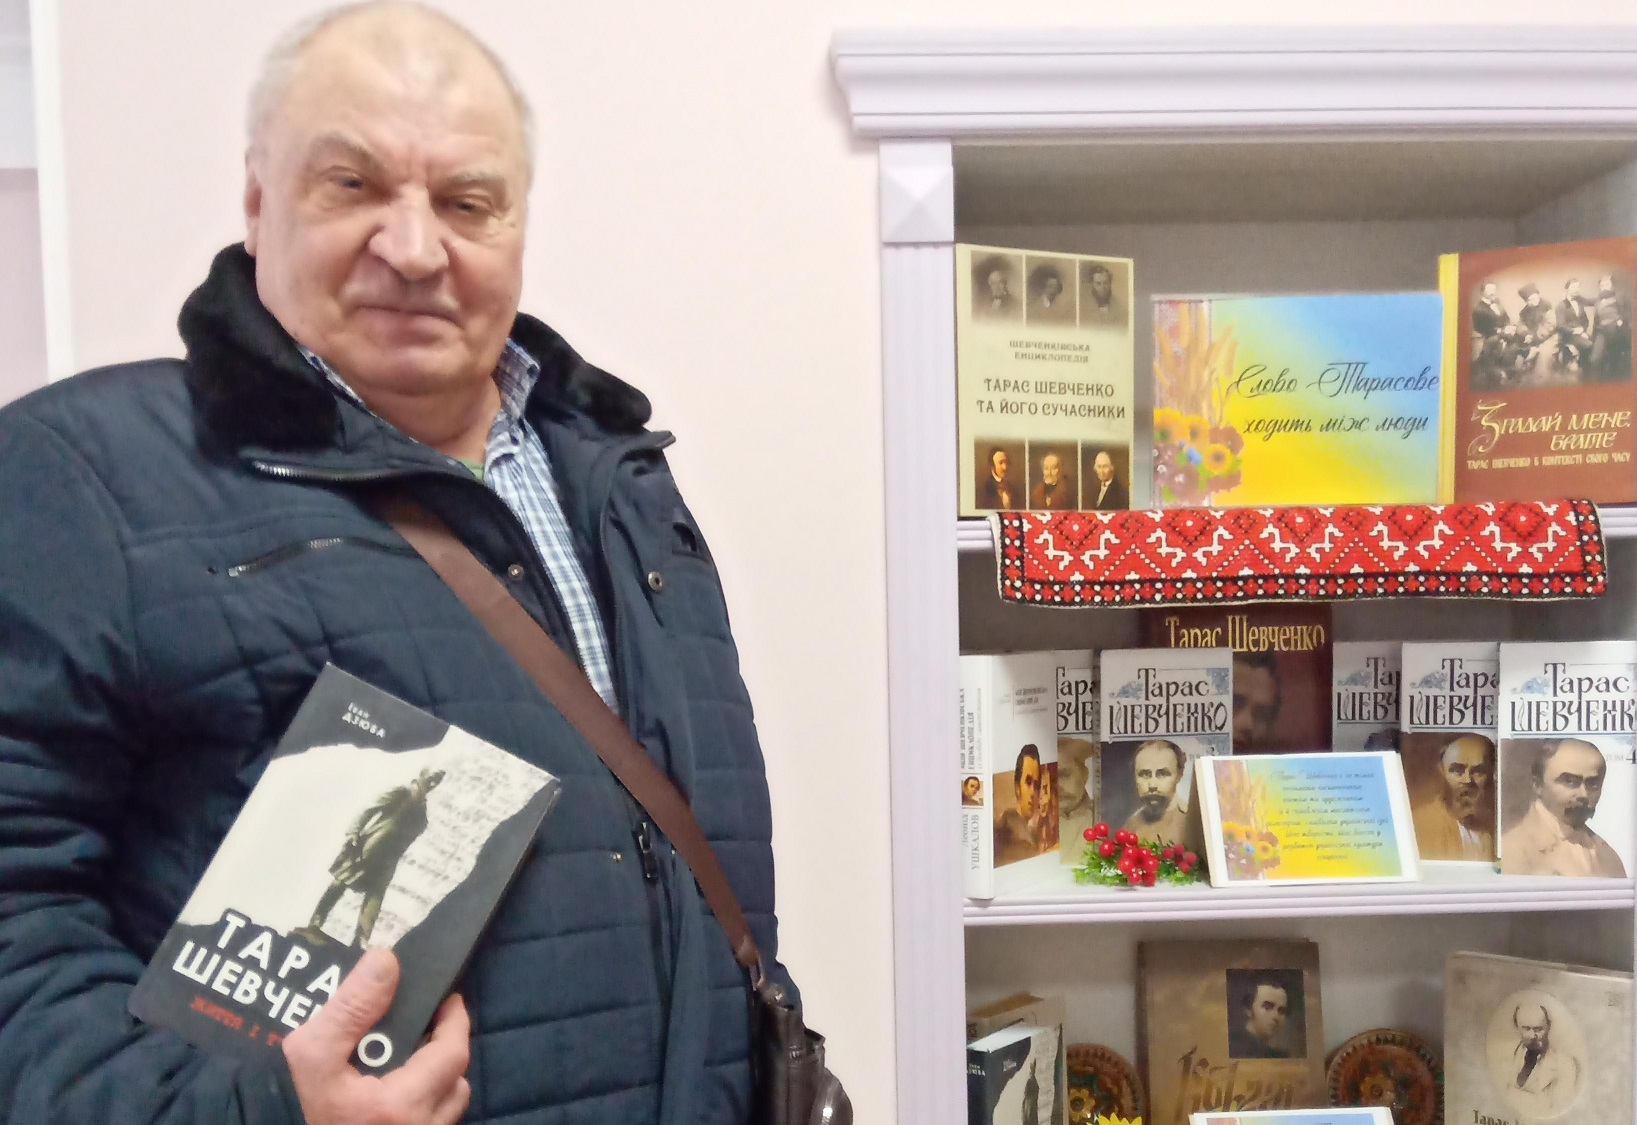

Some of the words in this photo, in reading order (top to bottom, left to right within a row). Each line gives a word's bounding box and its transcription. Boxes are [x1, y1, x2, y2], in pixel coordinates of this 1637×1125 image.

[1009, 339, 1091, 352] ШЕВЧЕНКІВСЬКА
[1014, 351, 1089, 363] ЕНЦИКЛОПЕДІЯ
[983, 378, 1030, 394] ТАРАС
[1034, 381, 1115, 398] ШЕВЧЕНКО
[1226, 364, 1298, 398] Слово
[1306, 362, 1439, 400] Тарасове
[976, 399, 995, 413] ТА
[999, 398, 1039, 416] ЙОГО
[1041, 402, 1126, 420] СУЧАСНИКИ
[1243, 417, 1313, 442] ходить
[1319, 414, 1370, 434] між
[1375, 415, 1429, 440] люди
[1165, 616, 1222, 648] Тарас
[1227, 615, 1325, 652] Шевченко
[1137, 667, 1211, 702] Тарас
[1543, 662, 1630, 698] Тарас
[1108, 701, 1228, 735] ШЕВЧЕНКО
[1510, 697, 1637, 732] ШЕВЧЕНК
[971, 814, 980, 870] УШКАЛОВ
